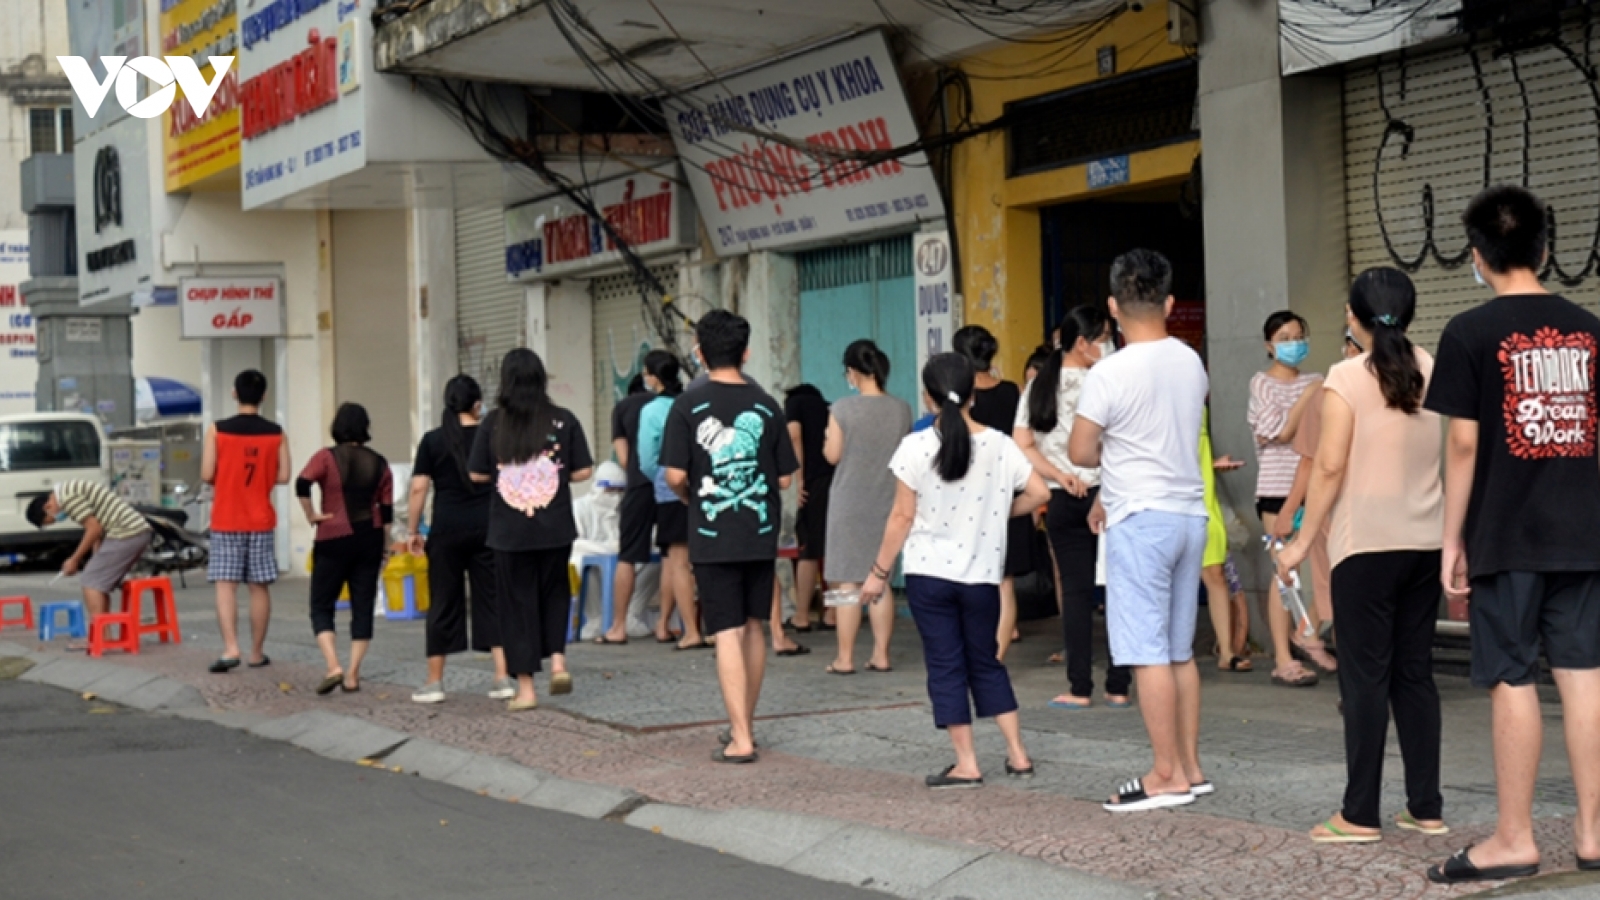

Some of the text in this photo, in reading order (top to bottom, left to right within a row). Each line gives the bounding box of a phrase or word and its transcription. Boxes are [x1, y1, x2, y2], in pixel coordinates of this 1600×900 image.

[748, 80, 797, 129] DỤNG
[792, 73, 823, 117] CỤ
[815, 69, 834, 106] Y
[830, 55, 885, 103] KHOA
[705, 138, 812, 217] PHƯỢNG
[212, 305, 253, 330] GẤP
[1511, 348, 1591, 392] TEAMWORK
[1524, 419, 1586, 445] Work
[244, 463, 256, 487] 7
